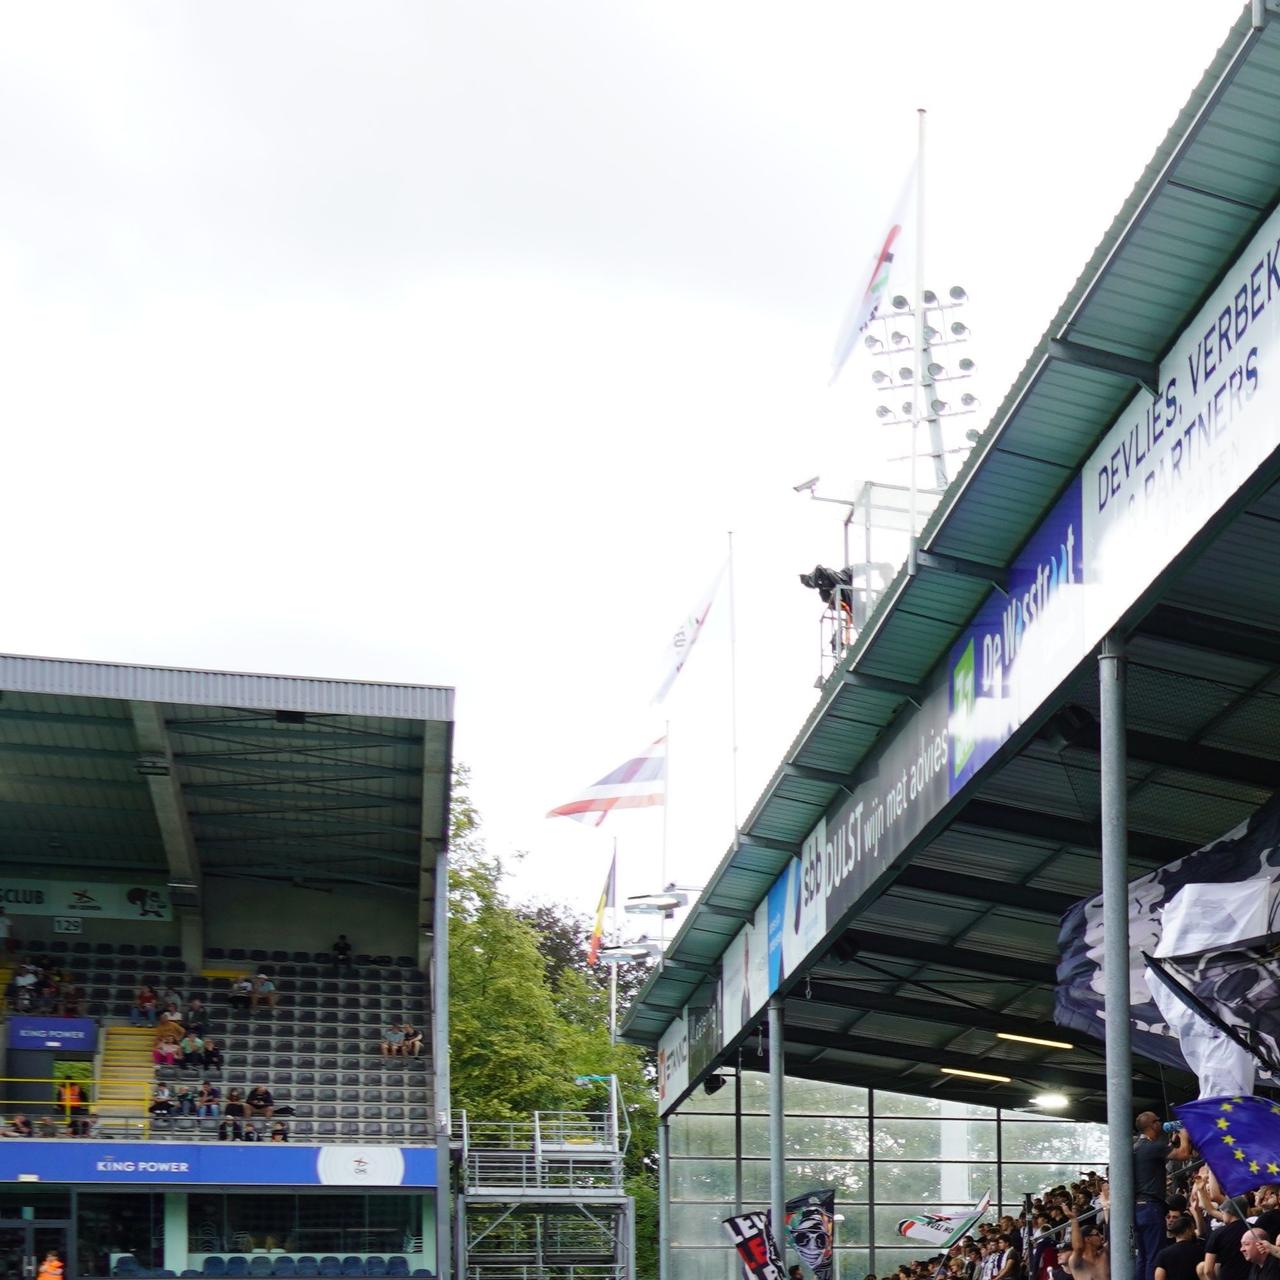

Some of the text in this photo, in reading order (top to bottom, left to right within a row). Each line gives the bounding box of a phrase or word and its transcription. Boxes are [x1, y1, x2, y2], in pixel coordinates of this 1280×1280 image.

[1098, 377, 1183, 514] DEVLIES,
[864, 797, 885, 857] wijn
[886, 767, 908, 827] met
[910, 729, 948, 800] advies
[96, 1161, 190, 1172] KING POWER
